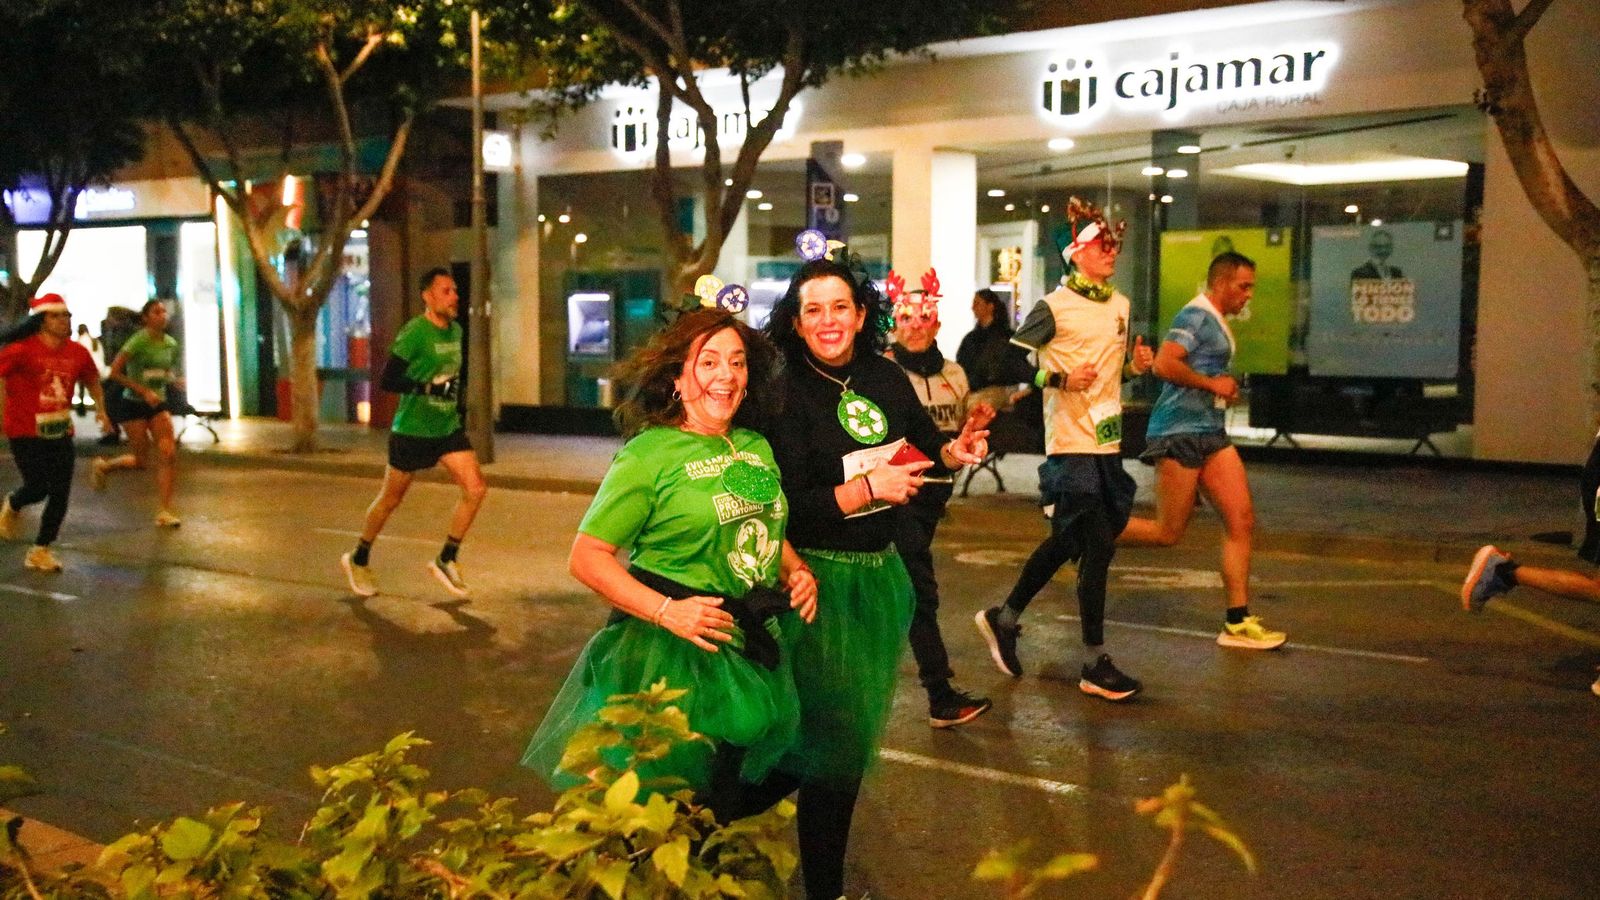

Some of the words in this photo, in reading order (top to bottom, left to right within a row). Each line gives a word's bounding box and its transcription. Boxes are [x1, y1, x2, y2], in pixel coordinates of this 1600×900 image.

[1115, 50, 1325, 111] cajamar
[1216, 98, 1260, 114] CAJA
[1352, 305, 1415, 323] TODO
[685, 461, 704, 472] XVII
[687, 464, 721, 476] CIUDAD
